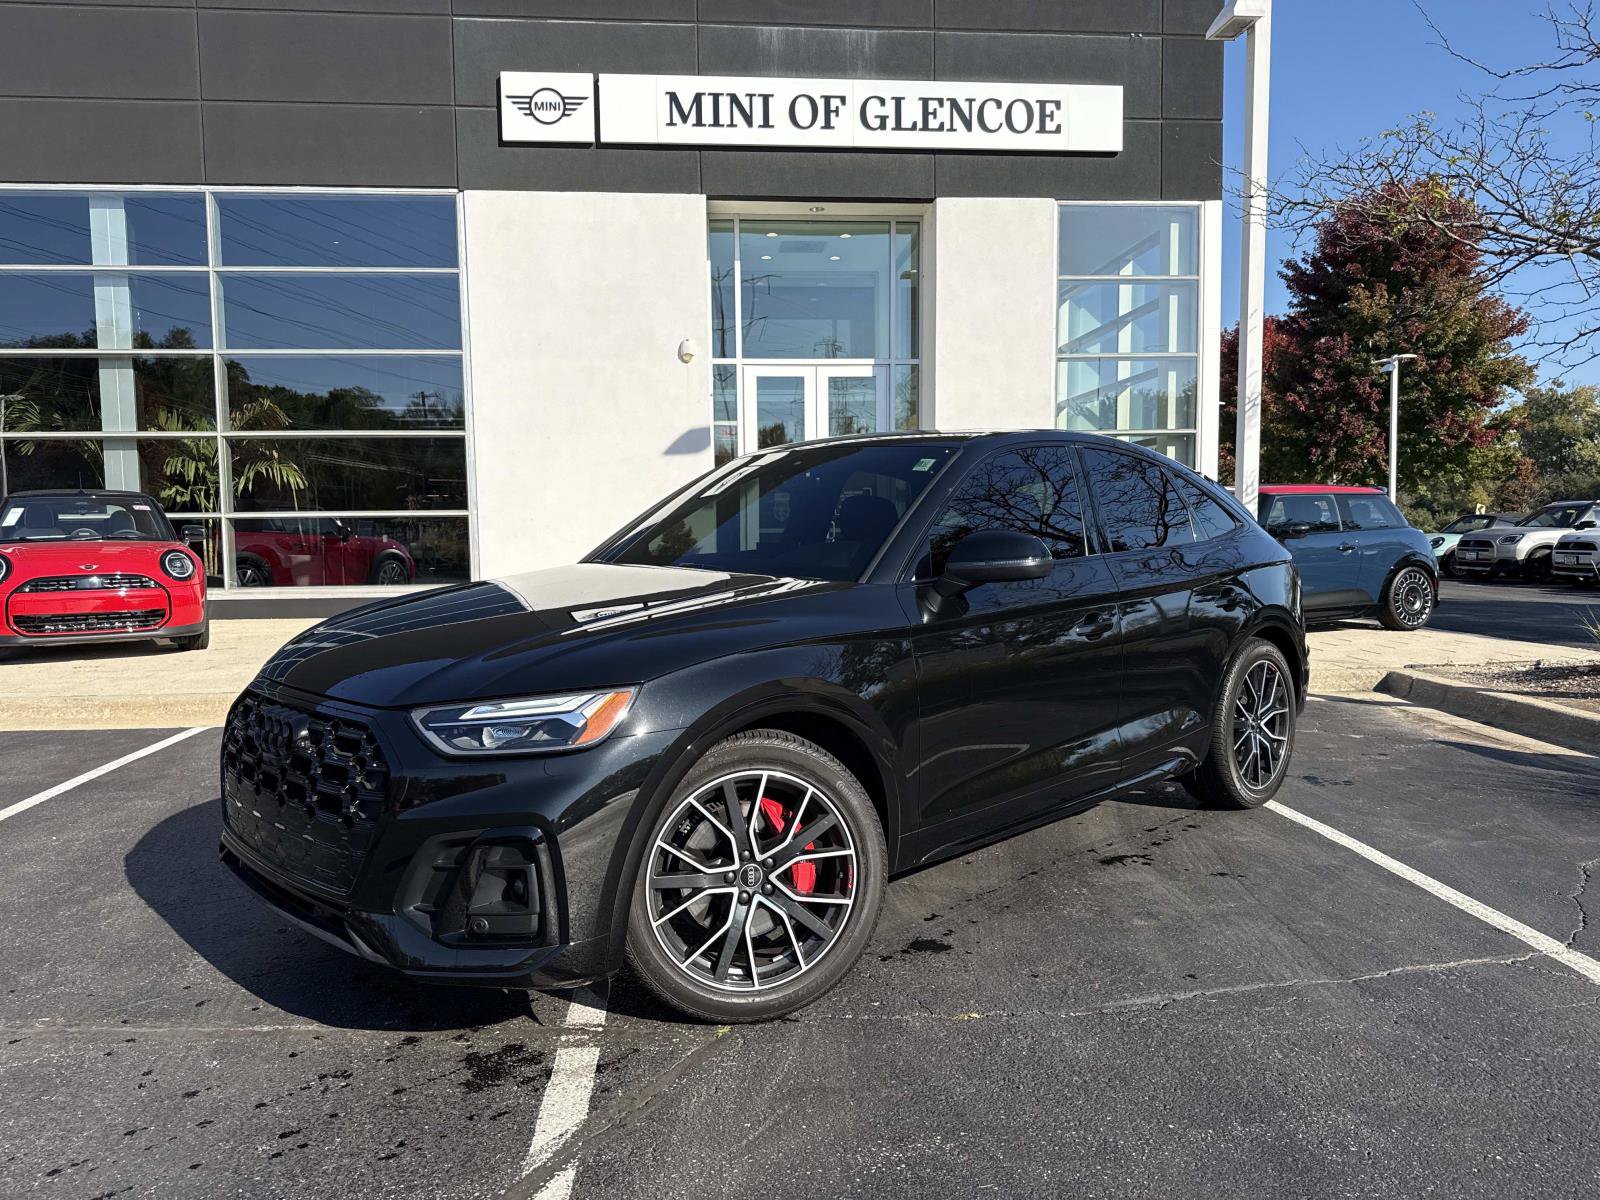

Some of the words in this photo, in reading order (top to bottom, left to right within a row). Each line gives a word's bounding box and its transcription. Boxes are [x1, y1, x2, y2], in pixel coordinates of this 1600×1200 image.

[534, 101, 561, 112] MINI
[664, 91, 775, 129] MINI
[788, 93, 847, 130] OF
[859, 95, 1062, 135] GLENCOE
